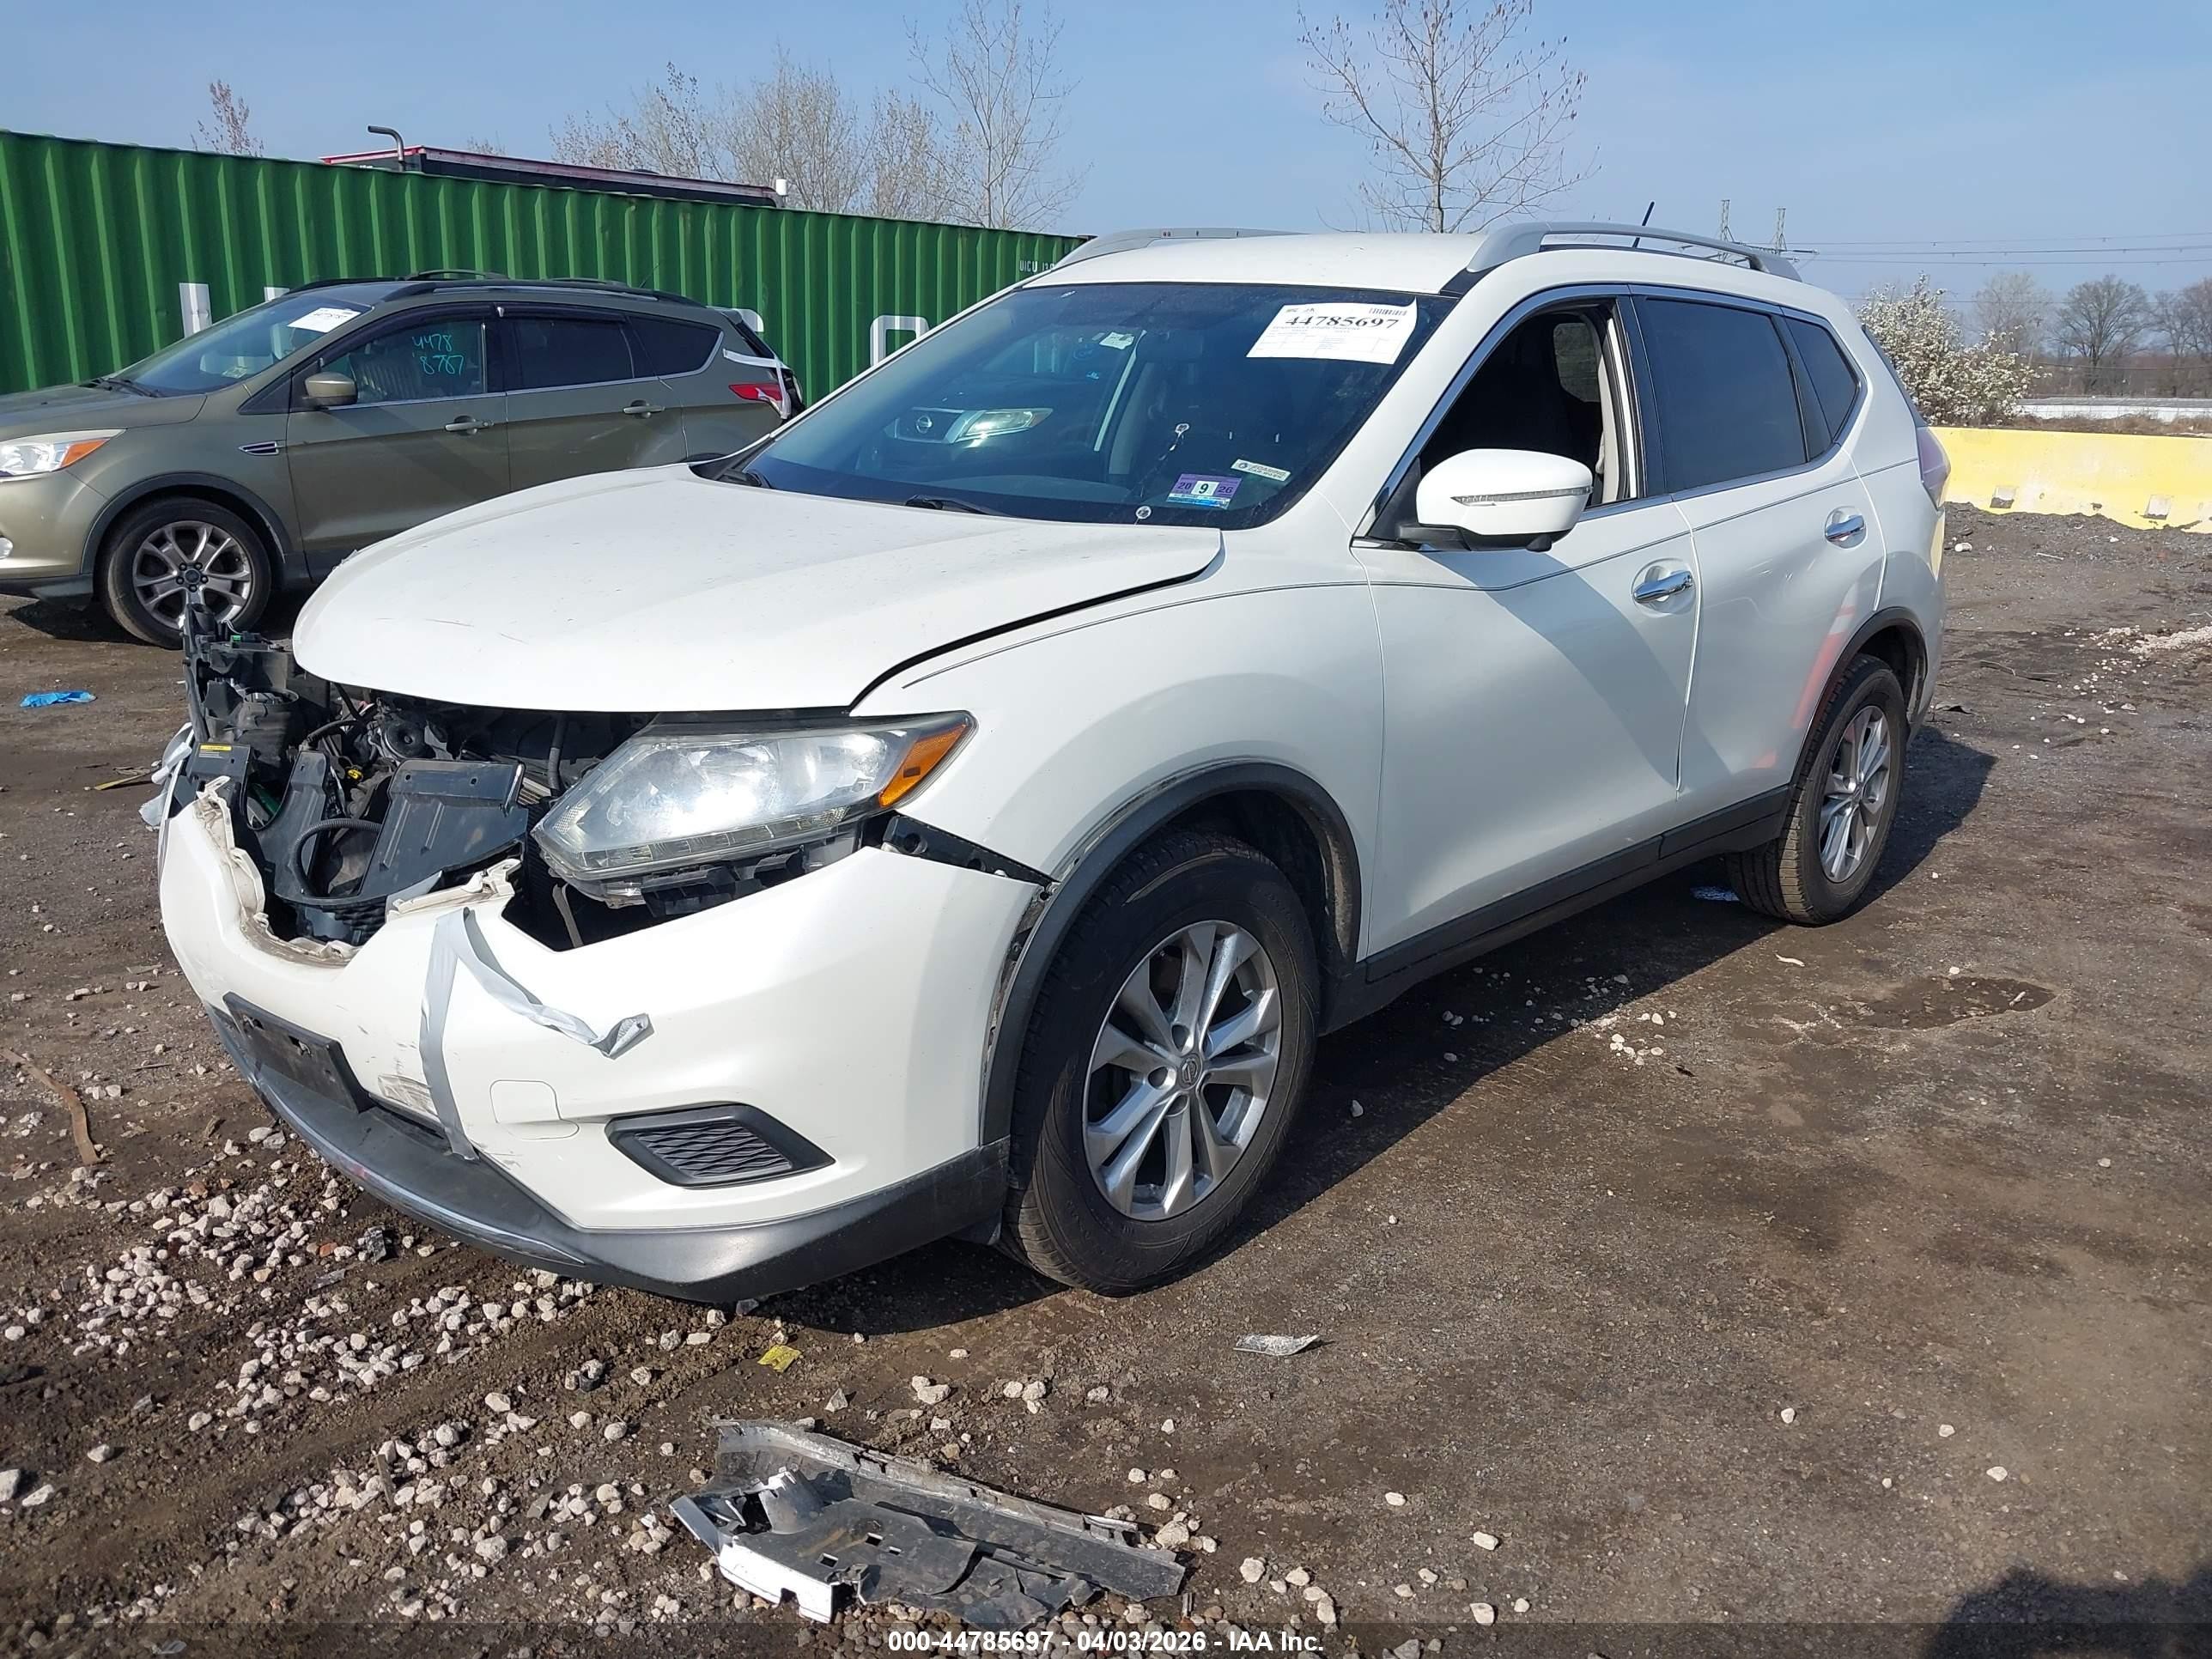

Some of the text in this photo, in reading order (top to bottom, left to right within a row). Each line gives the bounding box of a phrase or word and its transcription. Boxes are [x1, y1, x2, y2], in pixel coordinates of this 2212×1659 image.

[1285, 315, 1400, 329] 44785697
[412, 333, 453, 352] 4478
[419, 354, 465, 376] 8787
[1177, 482, 1234, 495] 20 9 26
